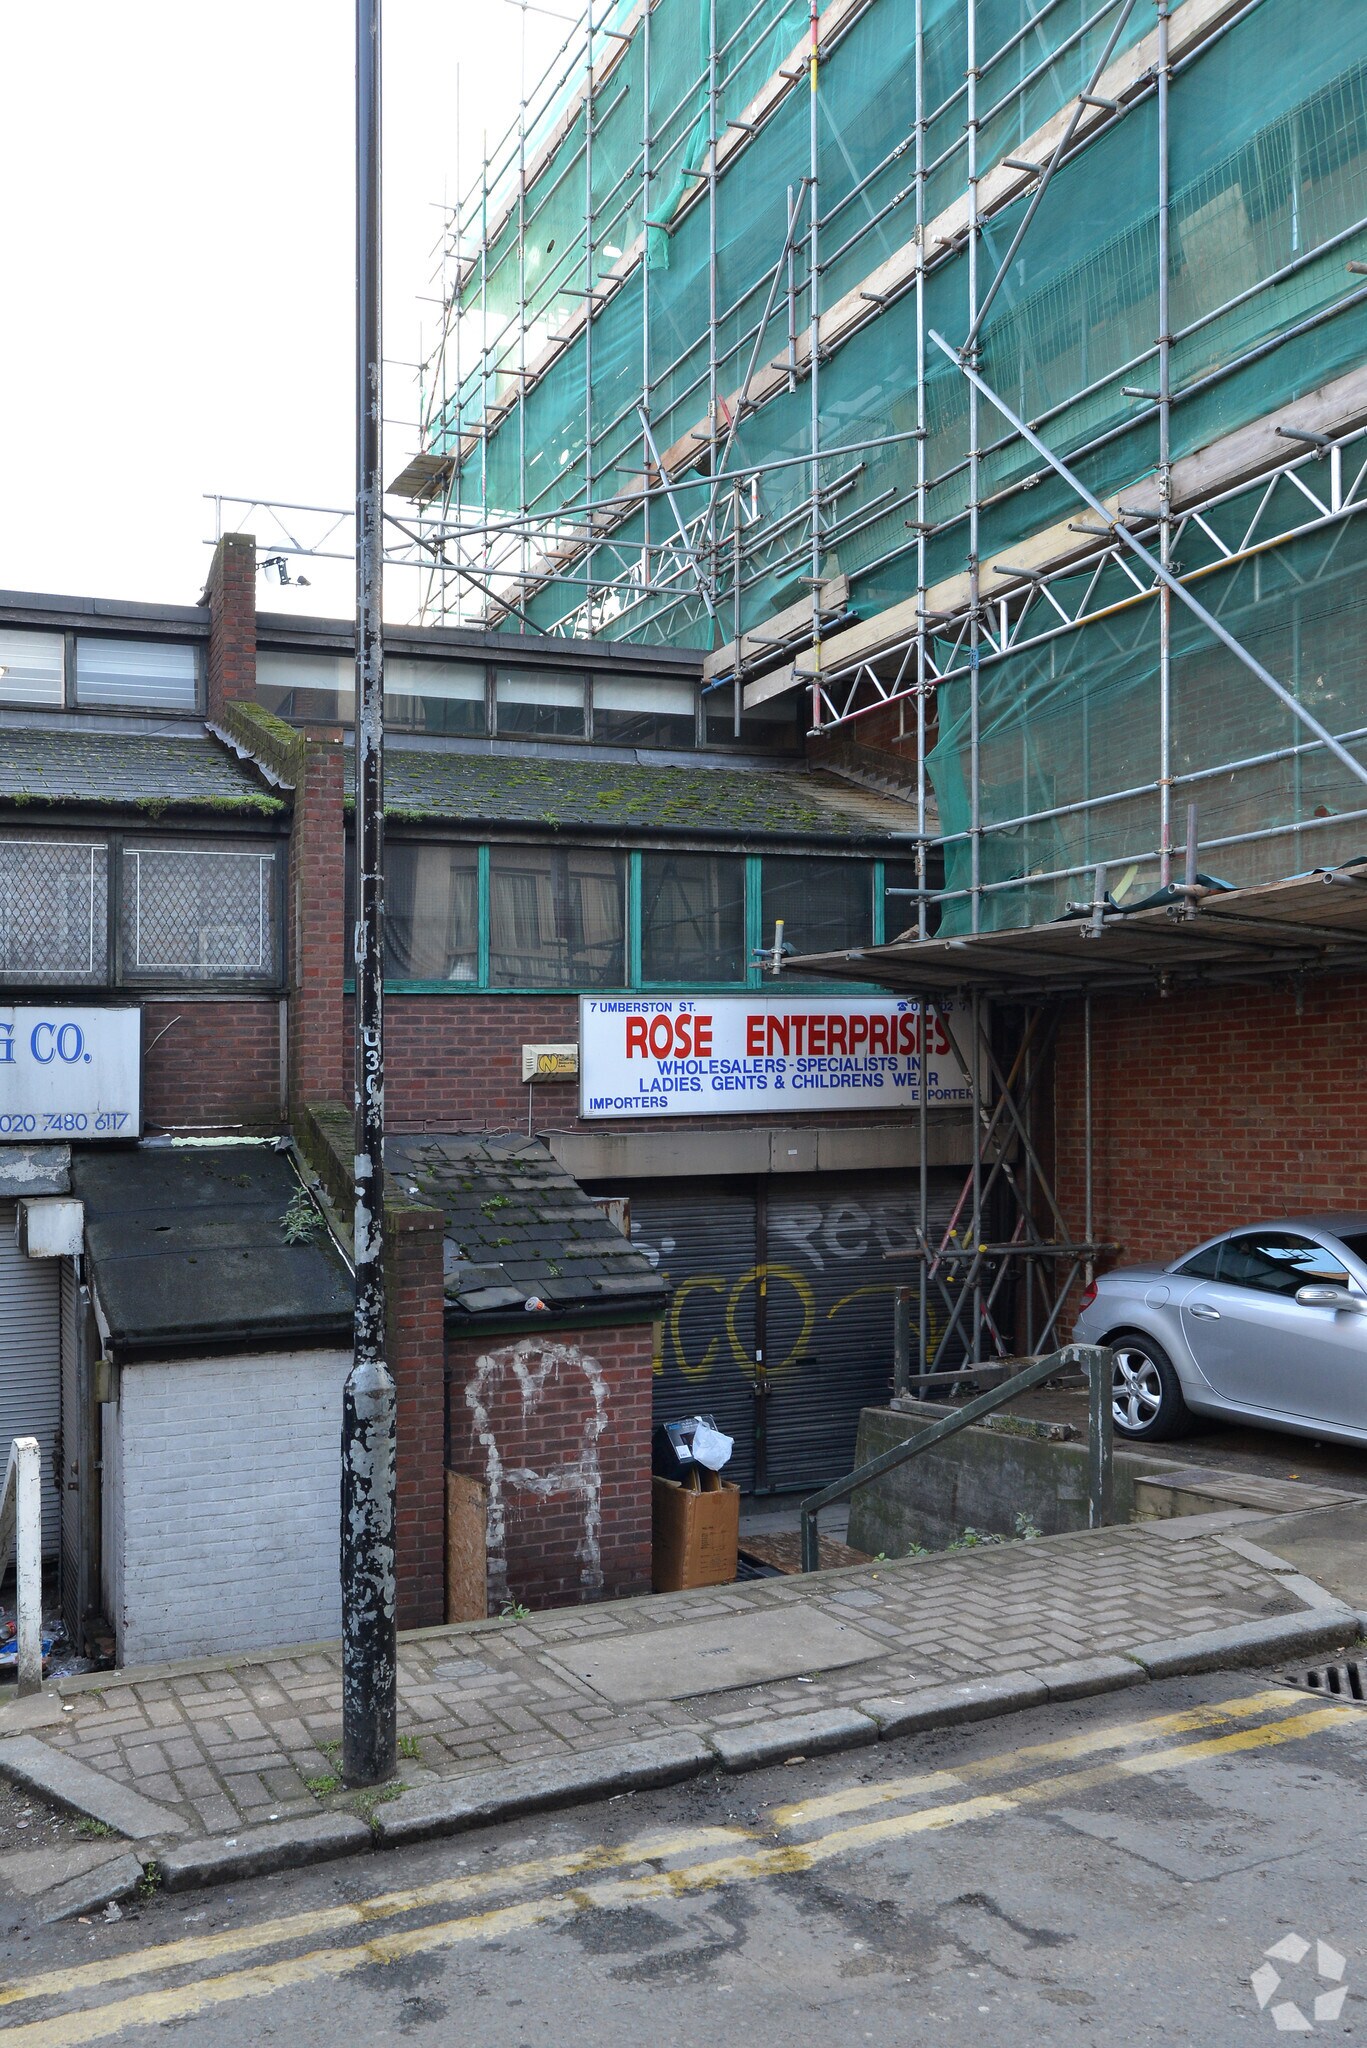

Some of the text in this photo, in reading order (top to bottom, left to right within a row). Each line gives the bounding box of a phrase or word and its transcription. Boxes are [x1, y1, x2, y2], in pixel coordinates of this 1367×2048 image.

[590, 1001, 696, 1012] 7 UMBERSTON ST.
[30, 1022, 92, 1063] CO.
[626, 1012, 951, 1059] ROSE ENTERPRISES
[657, 1058, 786, 1075] WHOLESALERS
[796, 1056, 898, 1072] SPECIALISTS
[907, 1056, 921, 1070] IN
[639, 1077, 704, 1093] LADIES,
[711, 1075, 768, 1091] GENTS
[774, 1074, 785, 1089] &
[791, 1073, 884, 1088] CHILDRENS
[589, 1096, 668, 1109] IMPORTERS
[911, 1089, 981, 1101] EPORTER
[0, 1113, 129, 1133] 020 7480 6117
